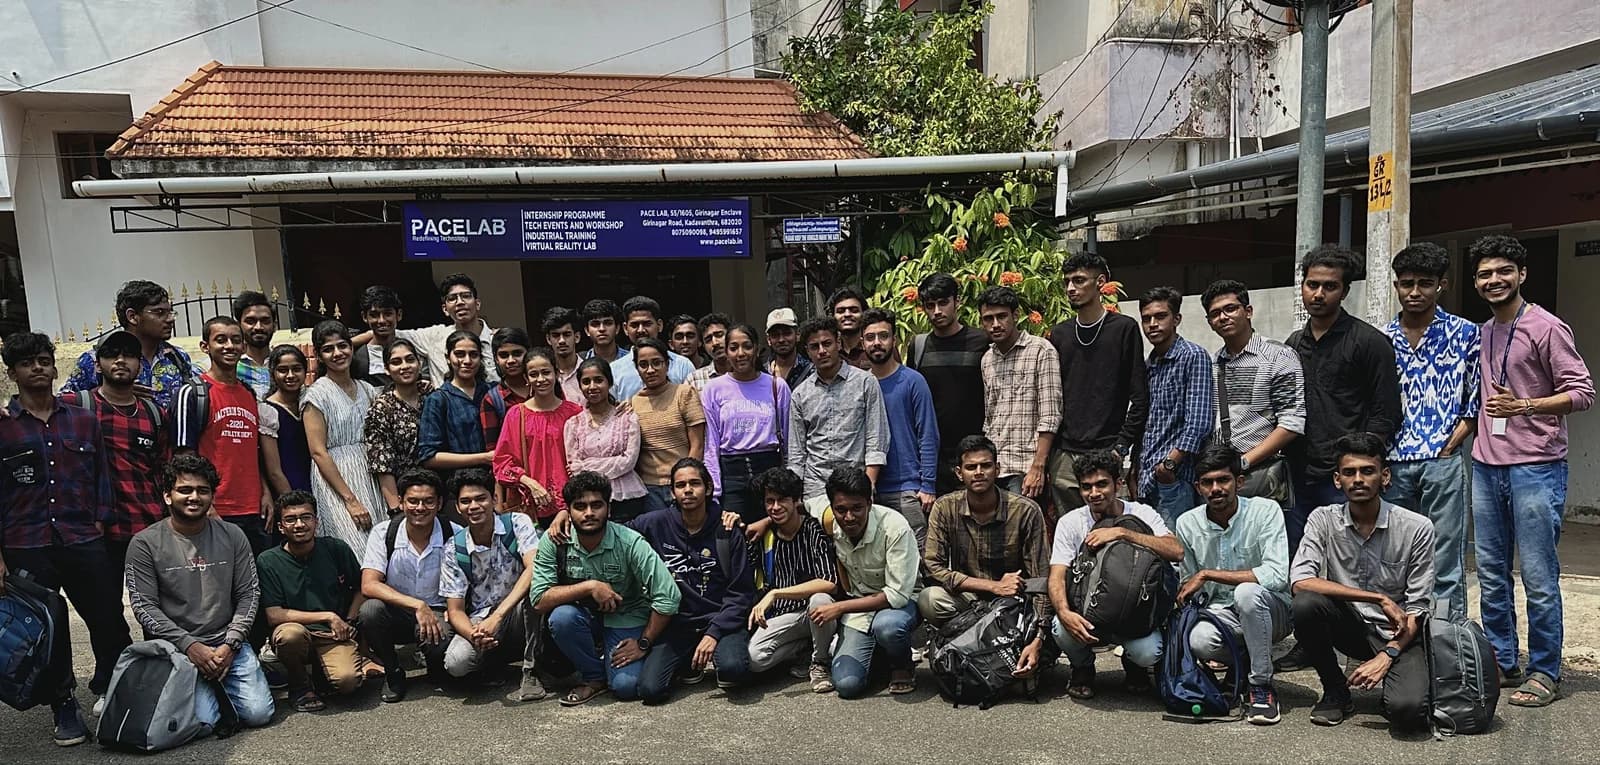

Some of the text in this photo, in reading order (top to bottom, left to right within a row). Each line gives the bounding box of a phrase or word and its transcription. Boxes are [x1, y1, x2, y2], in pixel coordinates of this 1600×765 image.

[524, 210, 606, 220] INTERNSHIP PROGRAMME
[656, 210, 669, 218] LAB,
[694, 209, 720, 218] Girinagar
[720, 209, 742, 217] Enclave
[411, 219, 505, 235] PACELAB
[525, 221, 624, 230] TECH EVENTS AND WORKSHOP
[642, 220, 667, 228] Girinagar
[720, 218, 743, 226] 682020
[440, 235, 468, 243] Technology
[525, 232, 597, 241] INDUSTRIAL TRAINING
[525, 242, 597, 251] VIRTUAL REALITY LAB
[700, 238, 743, 246] www.pacelab.in
